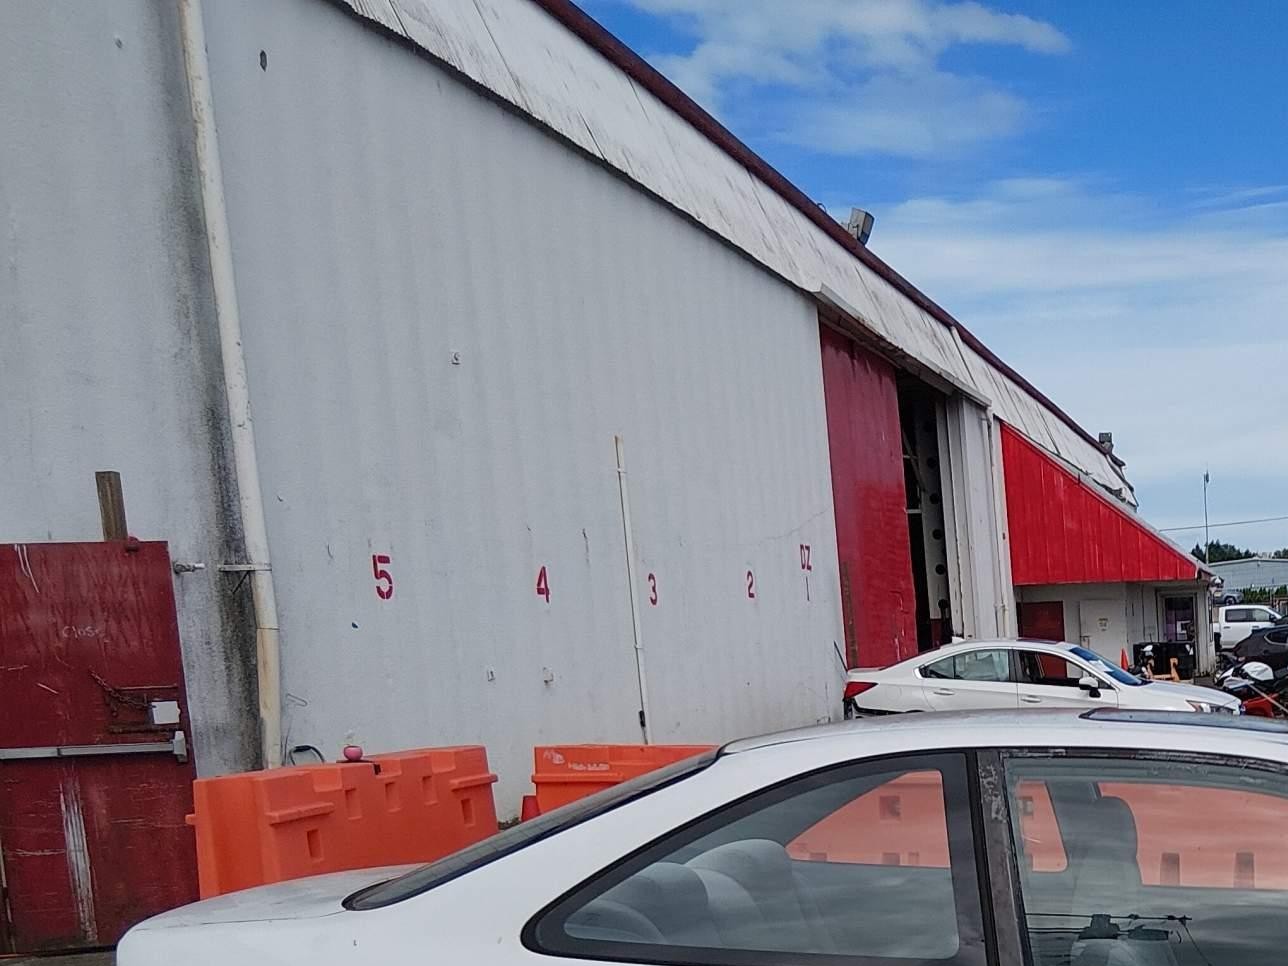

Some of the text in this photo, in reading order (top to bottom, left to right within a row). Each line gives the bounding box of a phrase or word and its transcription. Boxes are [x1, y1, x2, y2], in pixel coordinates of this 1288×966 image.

[372, 554, 393, 600] 5
[536, 565, 550, 603] 4
[648, 573, 658, 606] 3
[746, 570, 755, 599] 2
